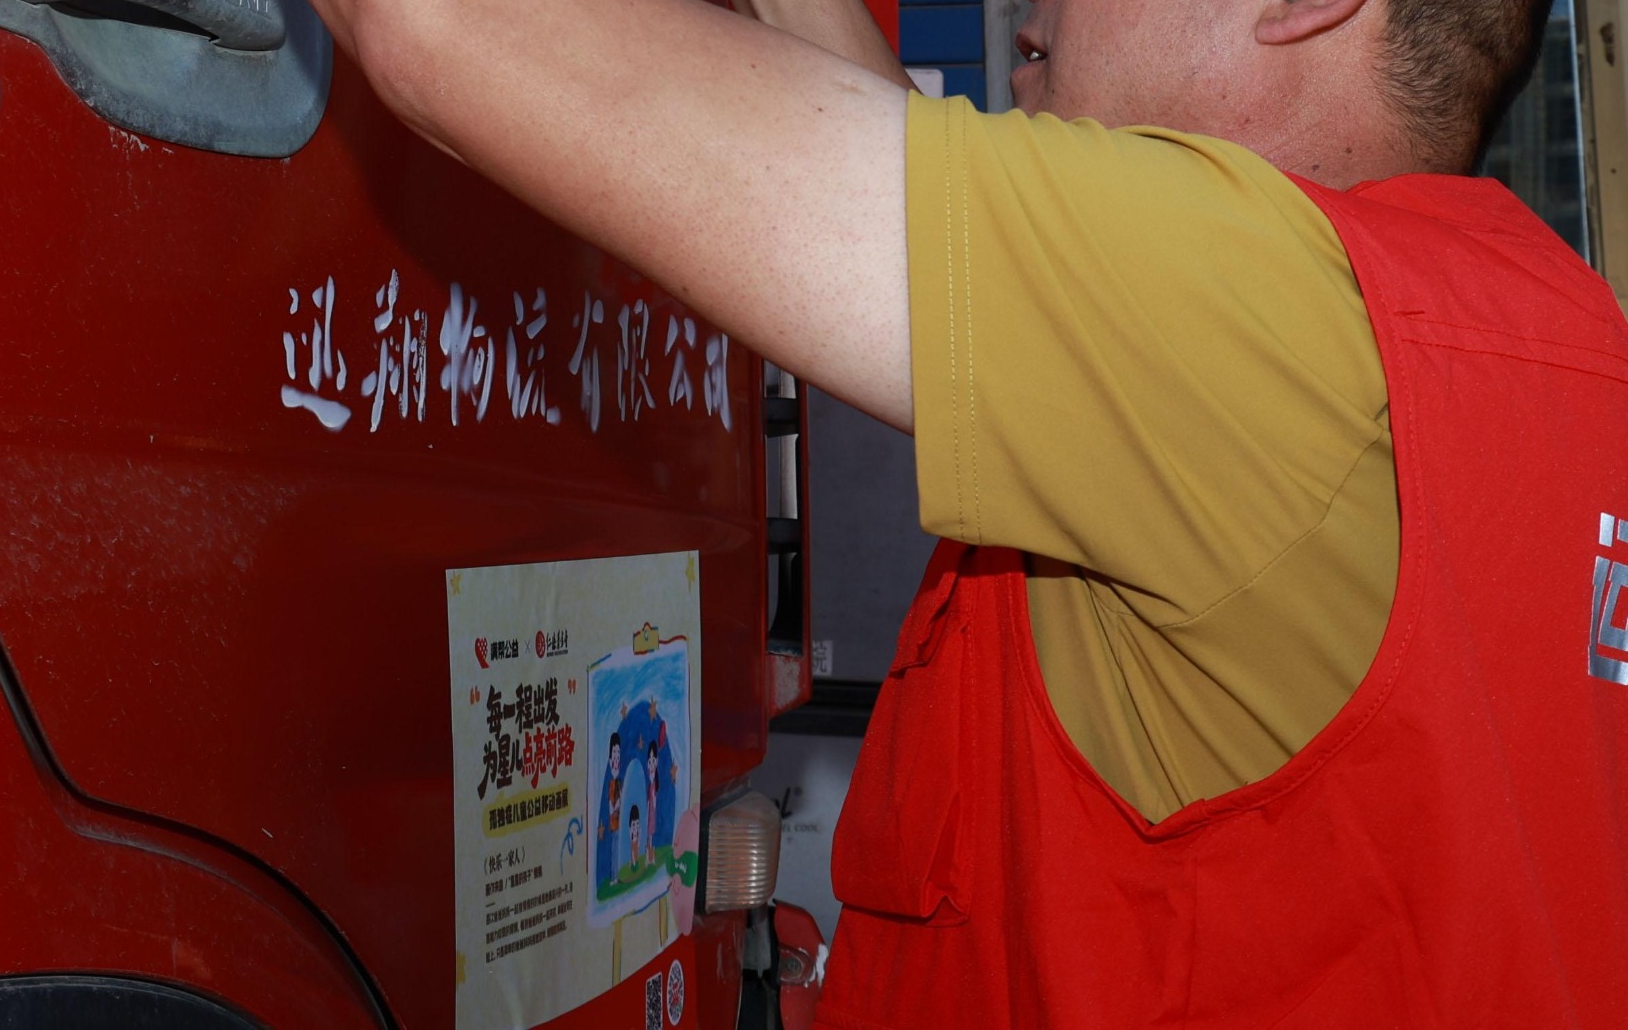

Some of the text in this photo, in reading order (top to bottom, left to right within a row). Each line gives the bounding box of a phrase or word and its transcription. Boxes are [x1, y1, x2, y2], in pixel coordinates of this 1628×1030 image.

[486, 676, 561, 741] 每一程出发
[477, 723, 575, 801] 为星儿点亮前路
